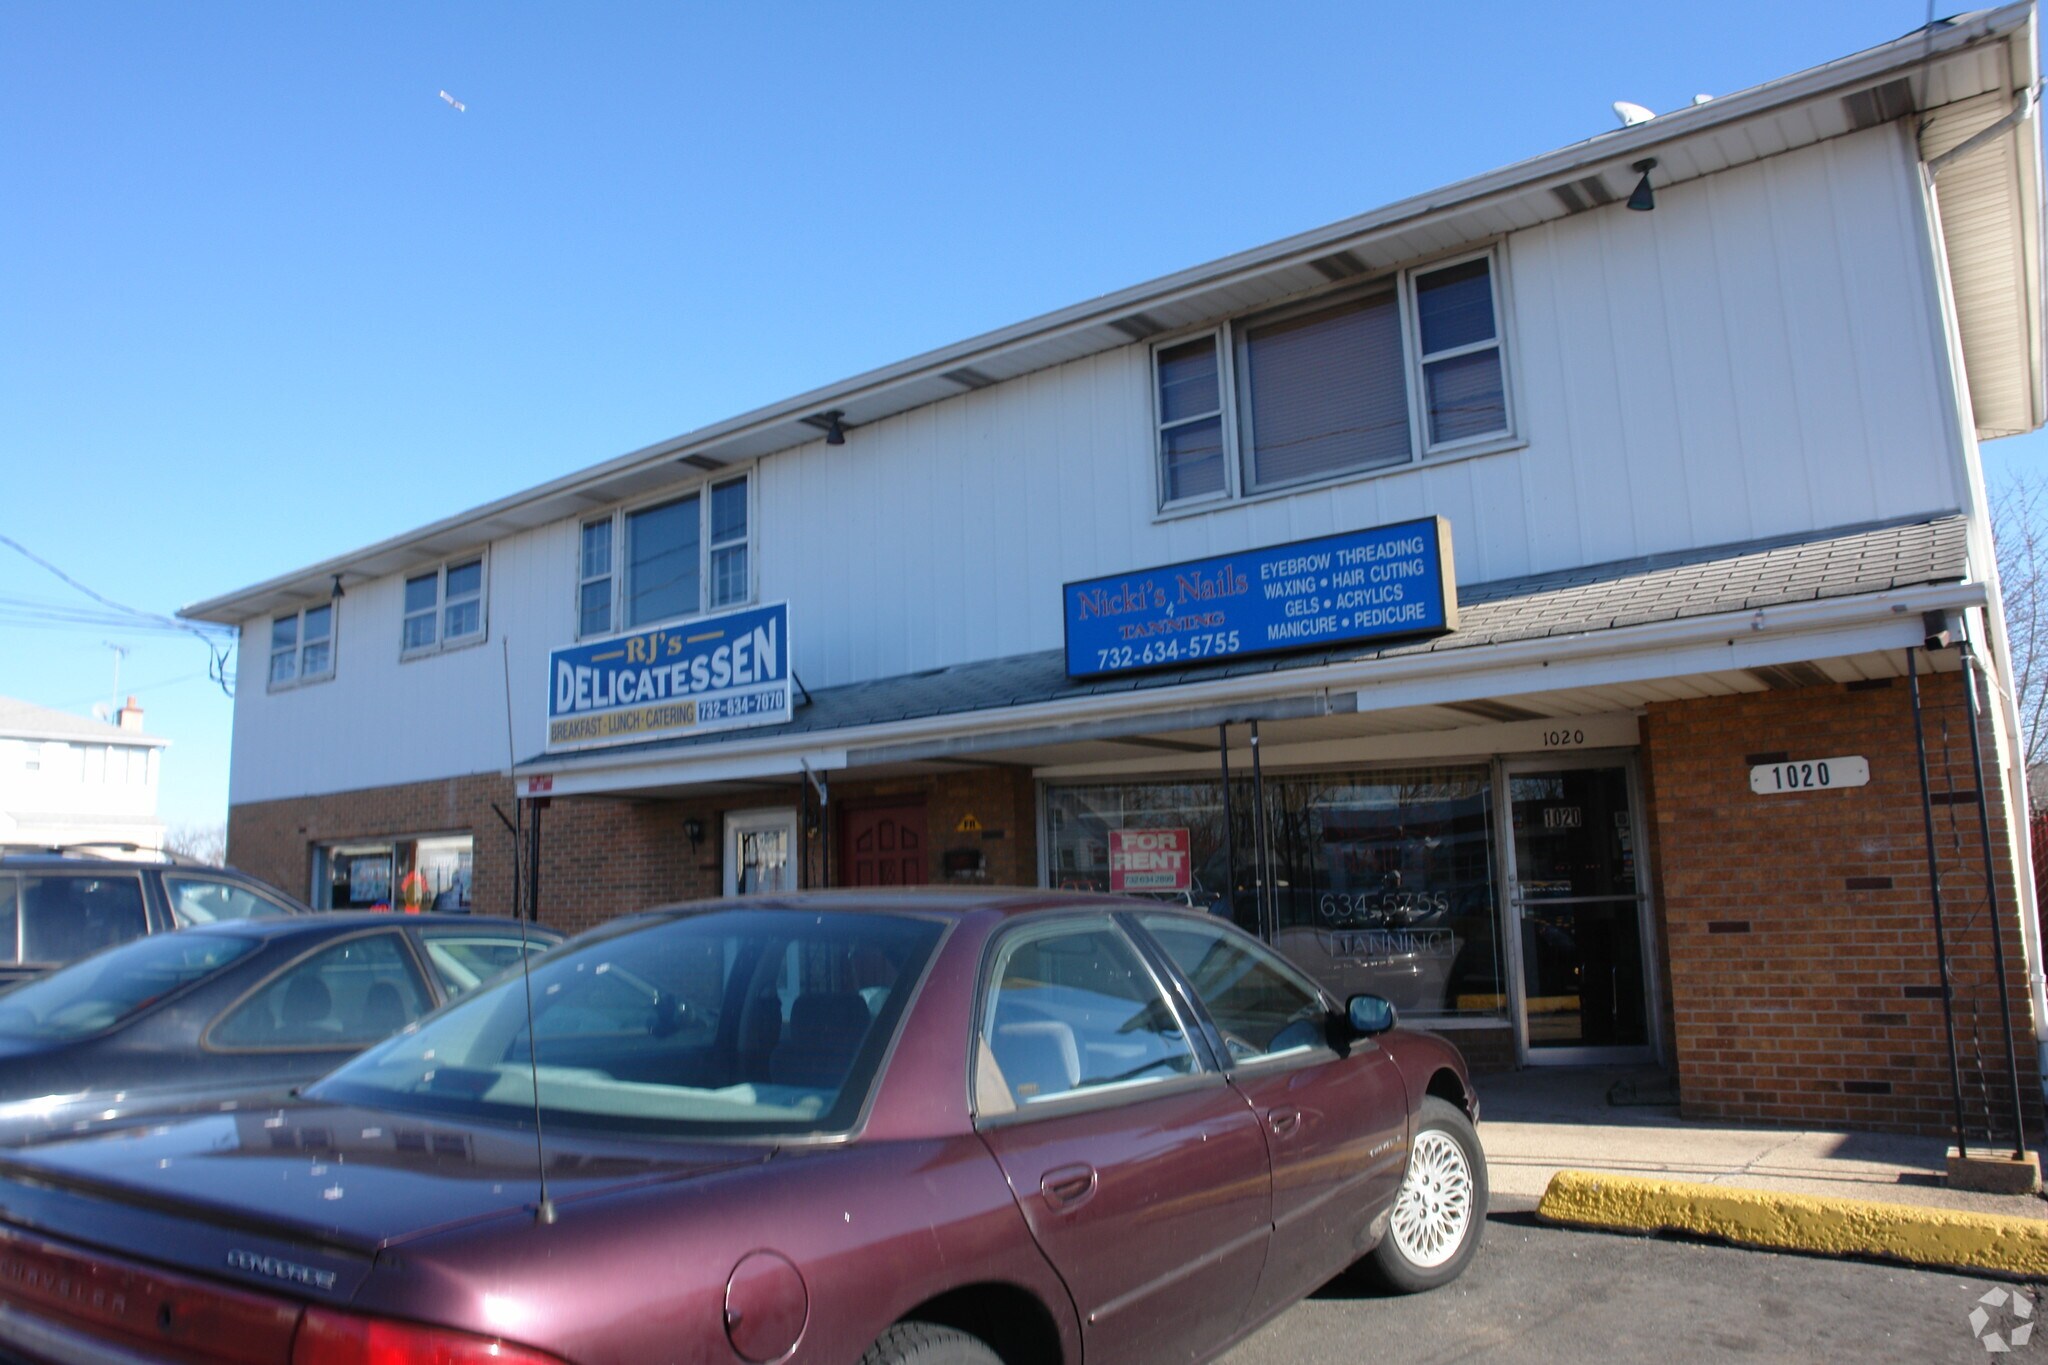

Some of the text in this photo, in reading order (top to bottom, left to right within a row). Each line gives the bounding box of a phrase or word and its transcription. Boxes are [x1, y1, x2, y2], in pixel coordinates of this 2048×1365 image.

[1260, 536, 1424, 580] EYEBROW THREADING
[1077, 563, 1248, 620] Nicki's Nails
[1264, 558, 1424, 600] WAXING HAIR CUTING
[1285, 583, 1403, 617] GELS ACRYLICS
[1119, 610, 1225, 640] TANNING
[1267, 602, 1426, 640] MANICURE PEDICURE
[556, 615, 777, 714] DELICATESSEN
[626, 632, 682, 665] RJ's
[1098, 630, 1240, 670] 732-634-5755
[551, 703, 695, 741] BREAKFAST LUNCH CATERING
[700, 691, 783, 720] 732-634-7070
[1543, 729, 1584, 746] 1020
[1772, 762, 1830, 789] 1020
[1544, 808, 1582, 827] 1020
[1121, 833, 1177, 850] FOR
[1114, 851, 1186, 870] RENT
[1341, 931, 1444, 954] TANNING
